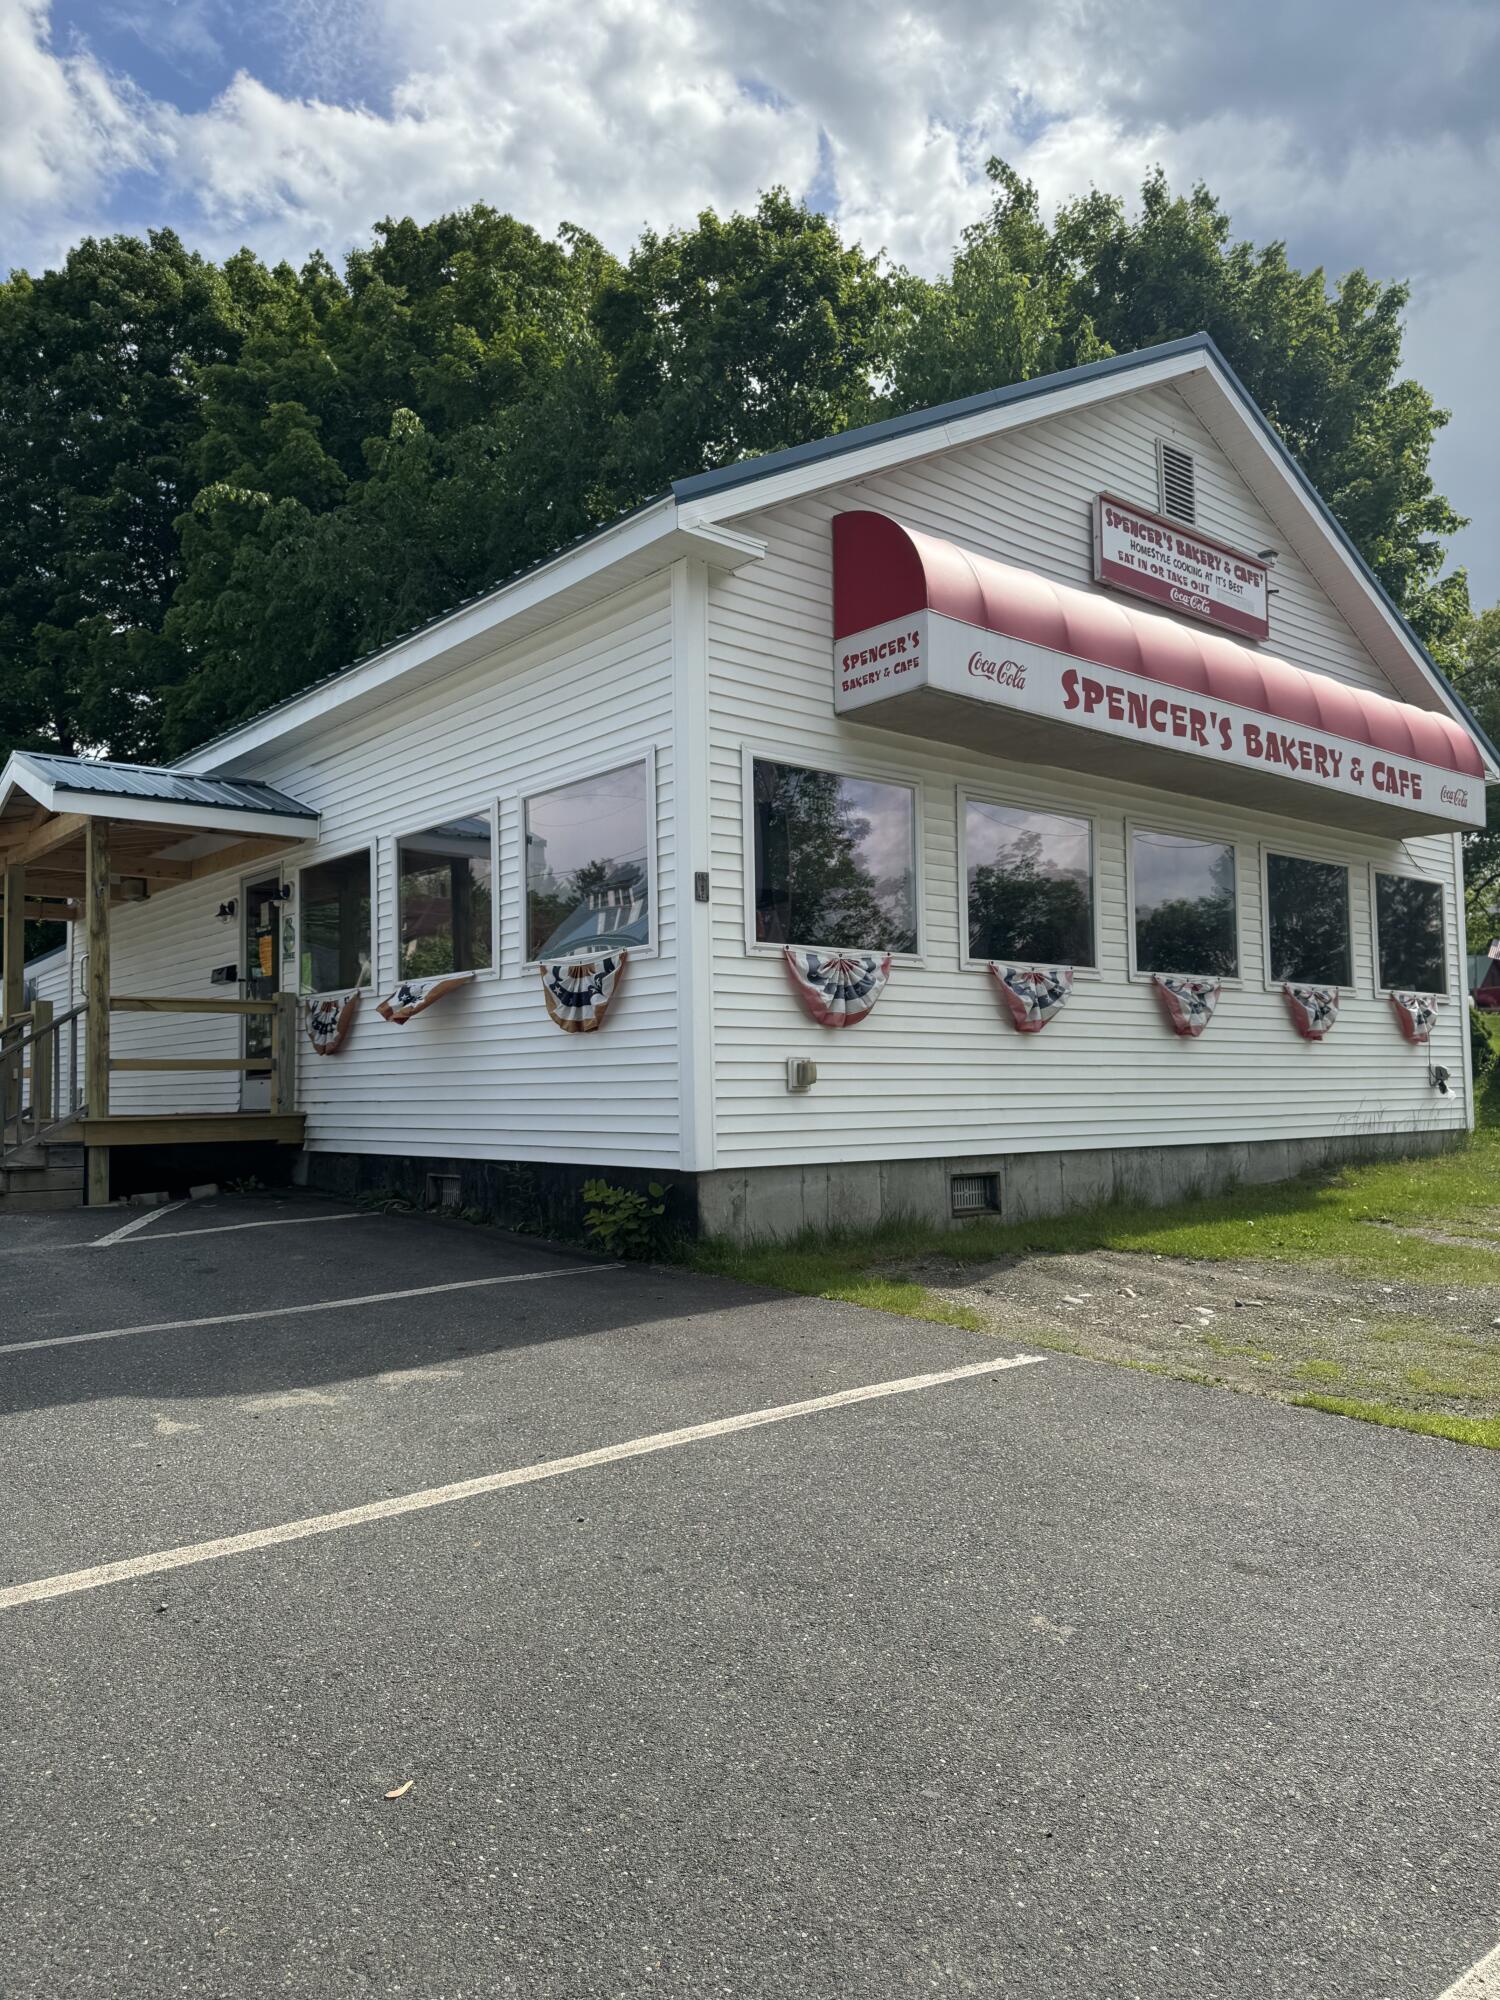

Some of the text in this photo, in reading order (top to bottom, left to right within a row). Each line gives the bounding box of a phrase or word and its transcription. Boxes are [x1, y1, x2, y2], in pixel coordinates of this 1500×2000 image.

[1105, 508, 1172, 551] SPENCER'S
[1176, 540, 1221, 571] BAKERY
[1224, 561, 1231, 575] &
[1118, 550, 1209, 595] EAT IN OR TAKE OUT
[1130, 539, 1243, 595] HOMESTYLE COOKING AT IT'S BEST
[842, 630, 920, 673] SPENCER'S
[842, 657, 919, 692] BAKERY & CAFE
[1061, 669, 1422, 800] SPENCER'S BAKERY & CAFE
